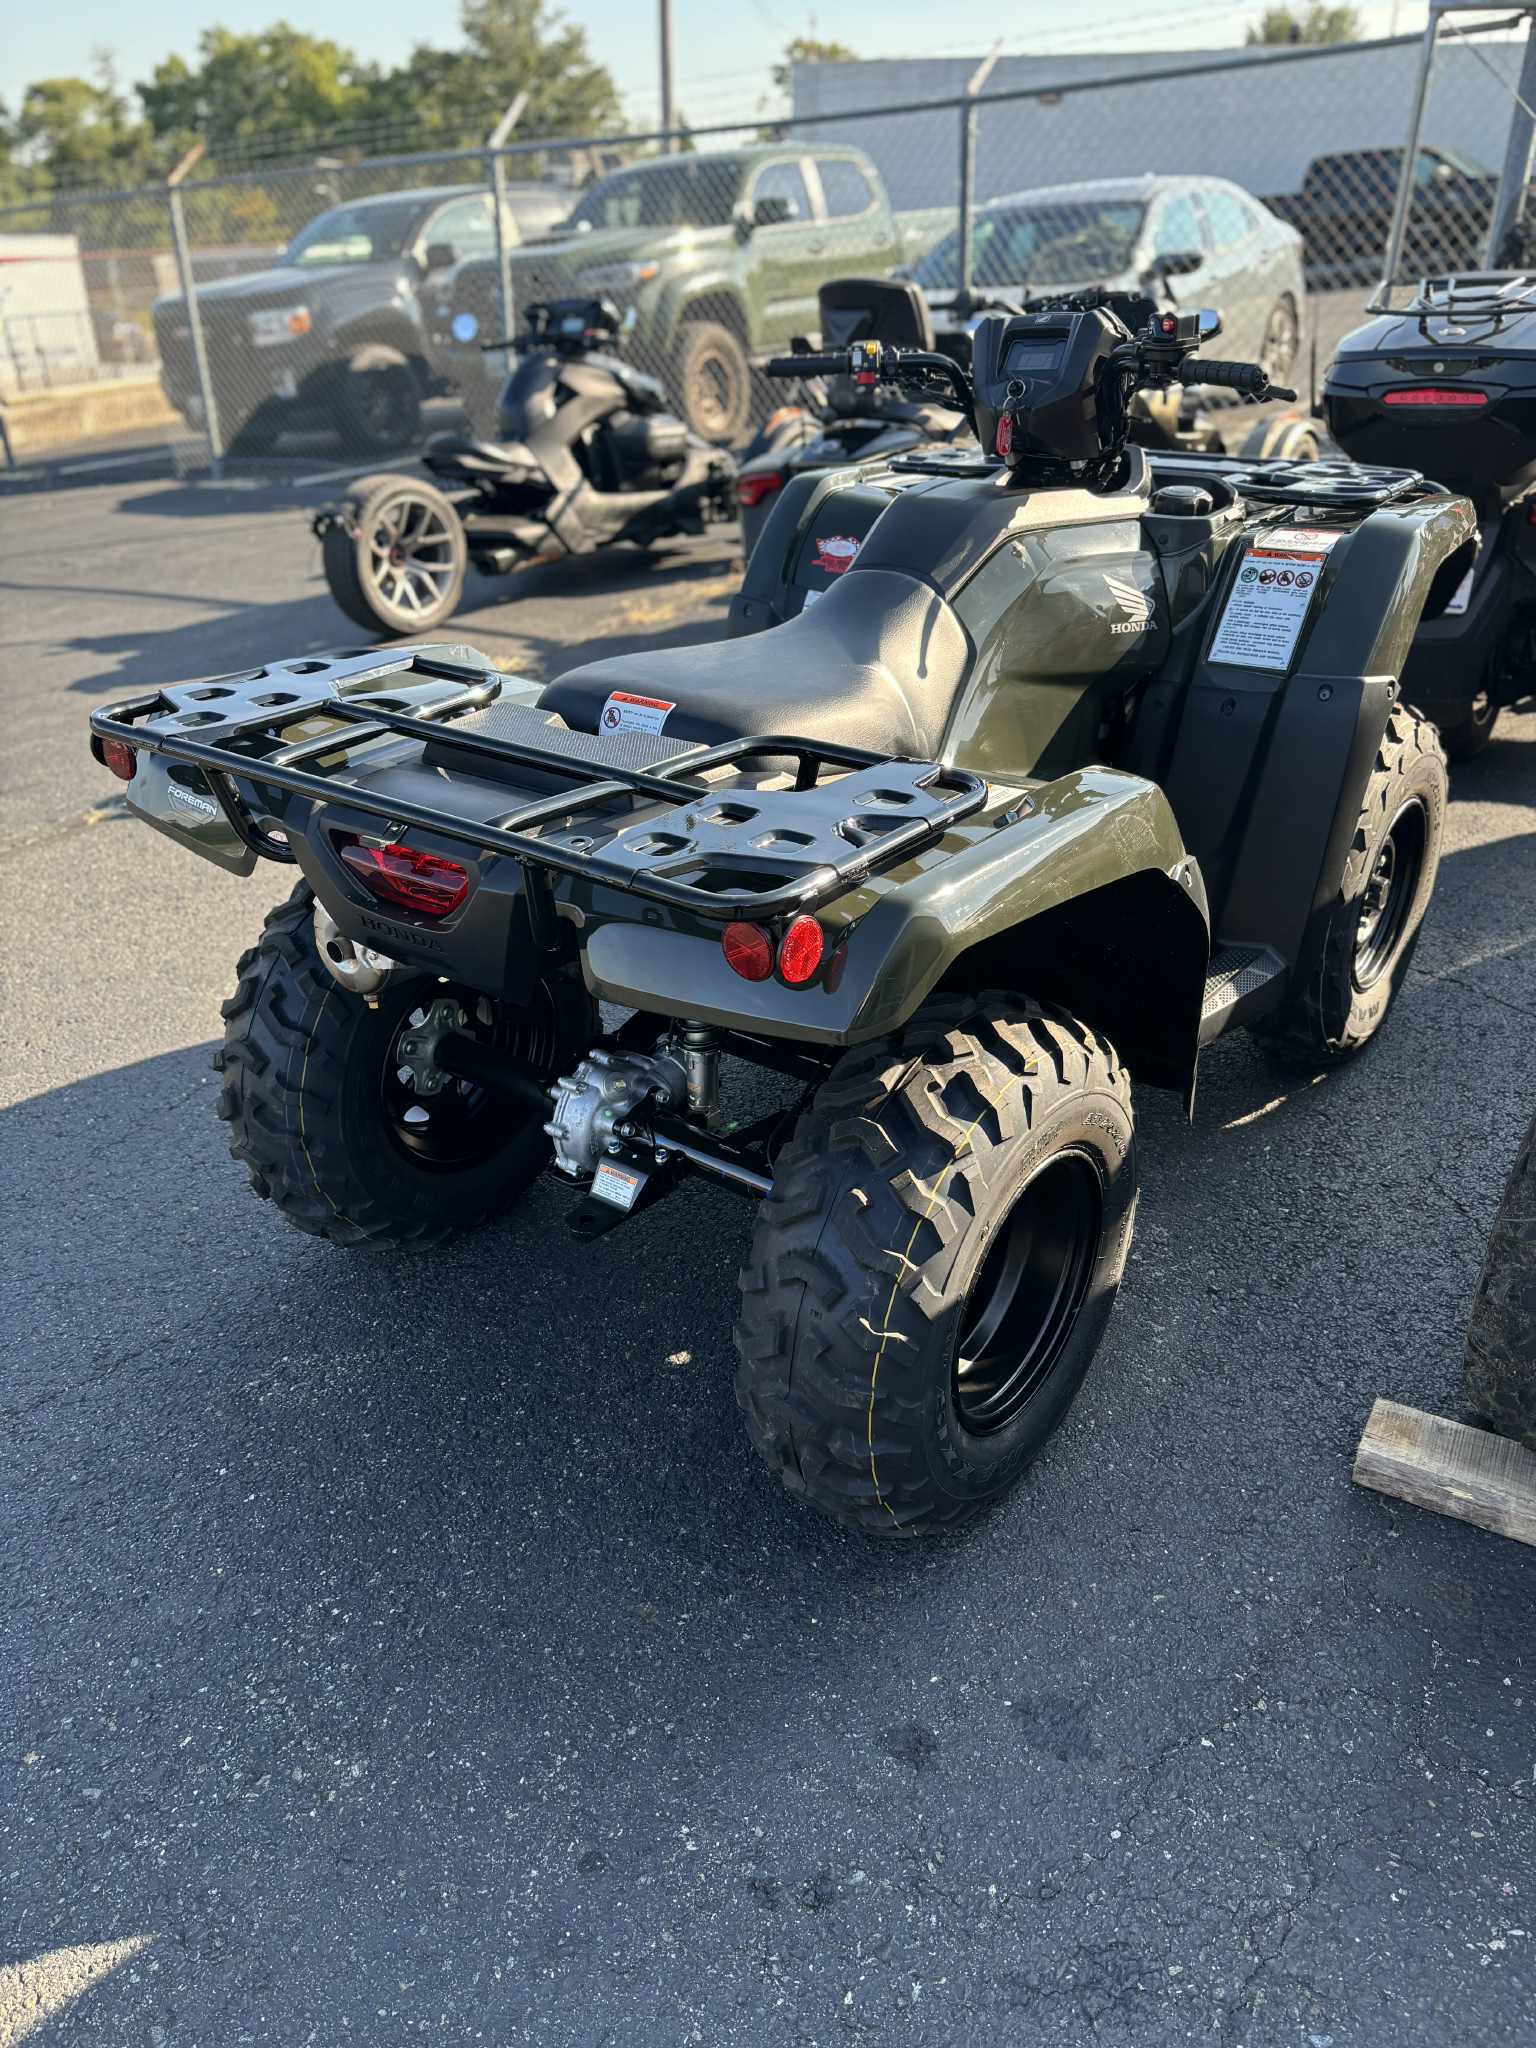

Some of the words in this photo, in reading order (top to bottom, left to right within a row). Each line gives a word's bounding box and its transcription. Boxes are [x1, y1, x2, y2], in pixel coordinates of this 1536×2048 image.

[1111, 620, 1158, 634] HONDA
[168, 785, 217, 815] FOREMAN
[359, 913, 441, 950] HONDA
